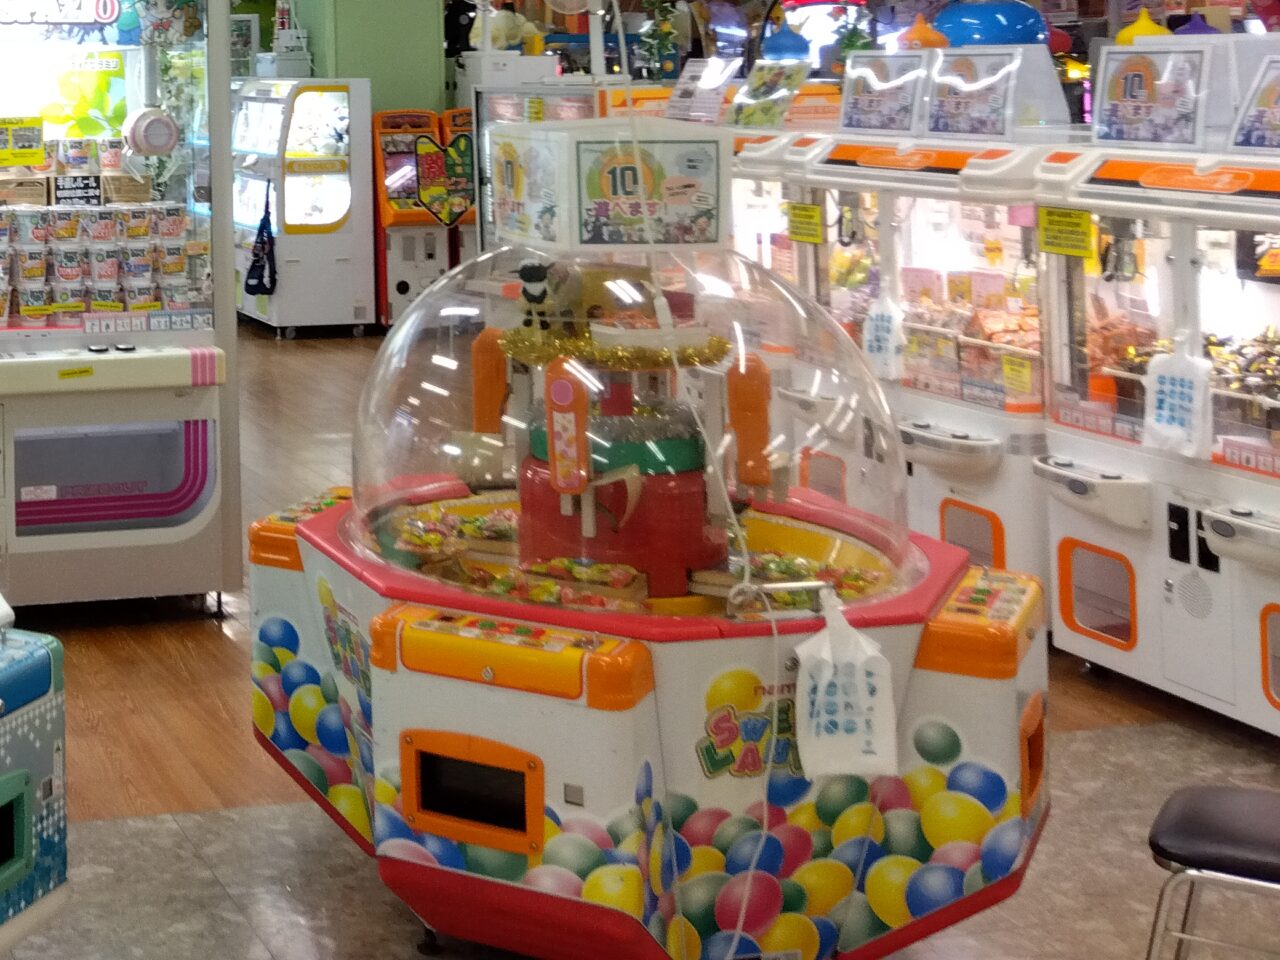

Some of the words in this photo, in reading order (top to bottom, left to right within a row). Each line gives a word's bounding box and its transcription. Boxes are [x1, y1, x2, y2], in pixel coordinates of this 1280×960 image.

[606, 165, 639, 196] 10
[753, 682, 797, 696] nam
[706, 700, 796, 750] SWE
[696, 734, 804, 778] LAN
